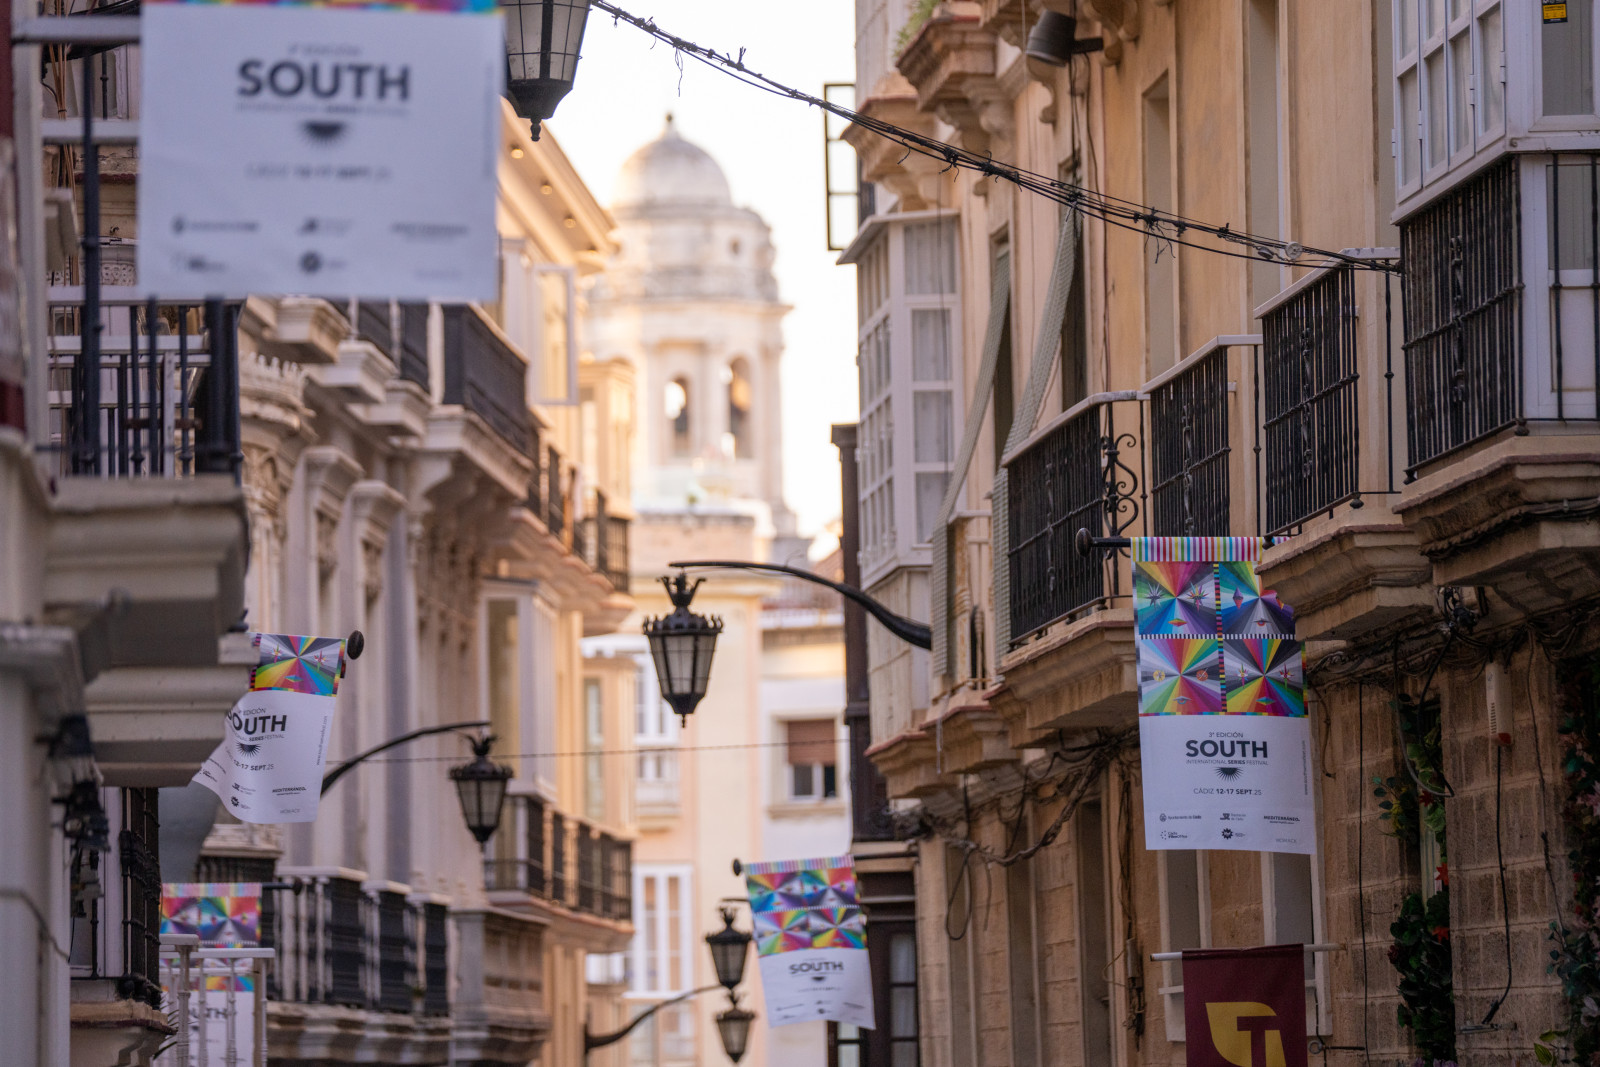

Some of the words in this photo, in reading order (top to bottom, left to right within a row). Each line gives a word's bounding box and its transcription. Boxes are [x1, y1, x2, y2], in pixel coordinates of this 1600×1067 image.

[236, 58, 411, 102] SOUTH
[1185, 739, 1268, 758] SOUTH
[1193, 787, 1215, 795] CÁDIZ
[789, 961, 844, 974] SOUTH
